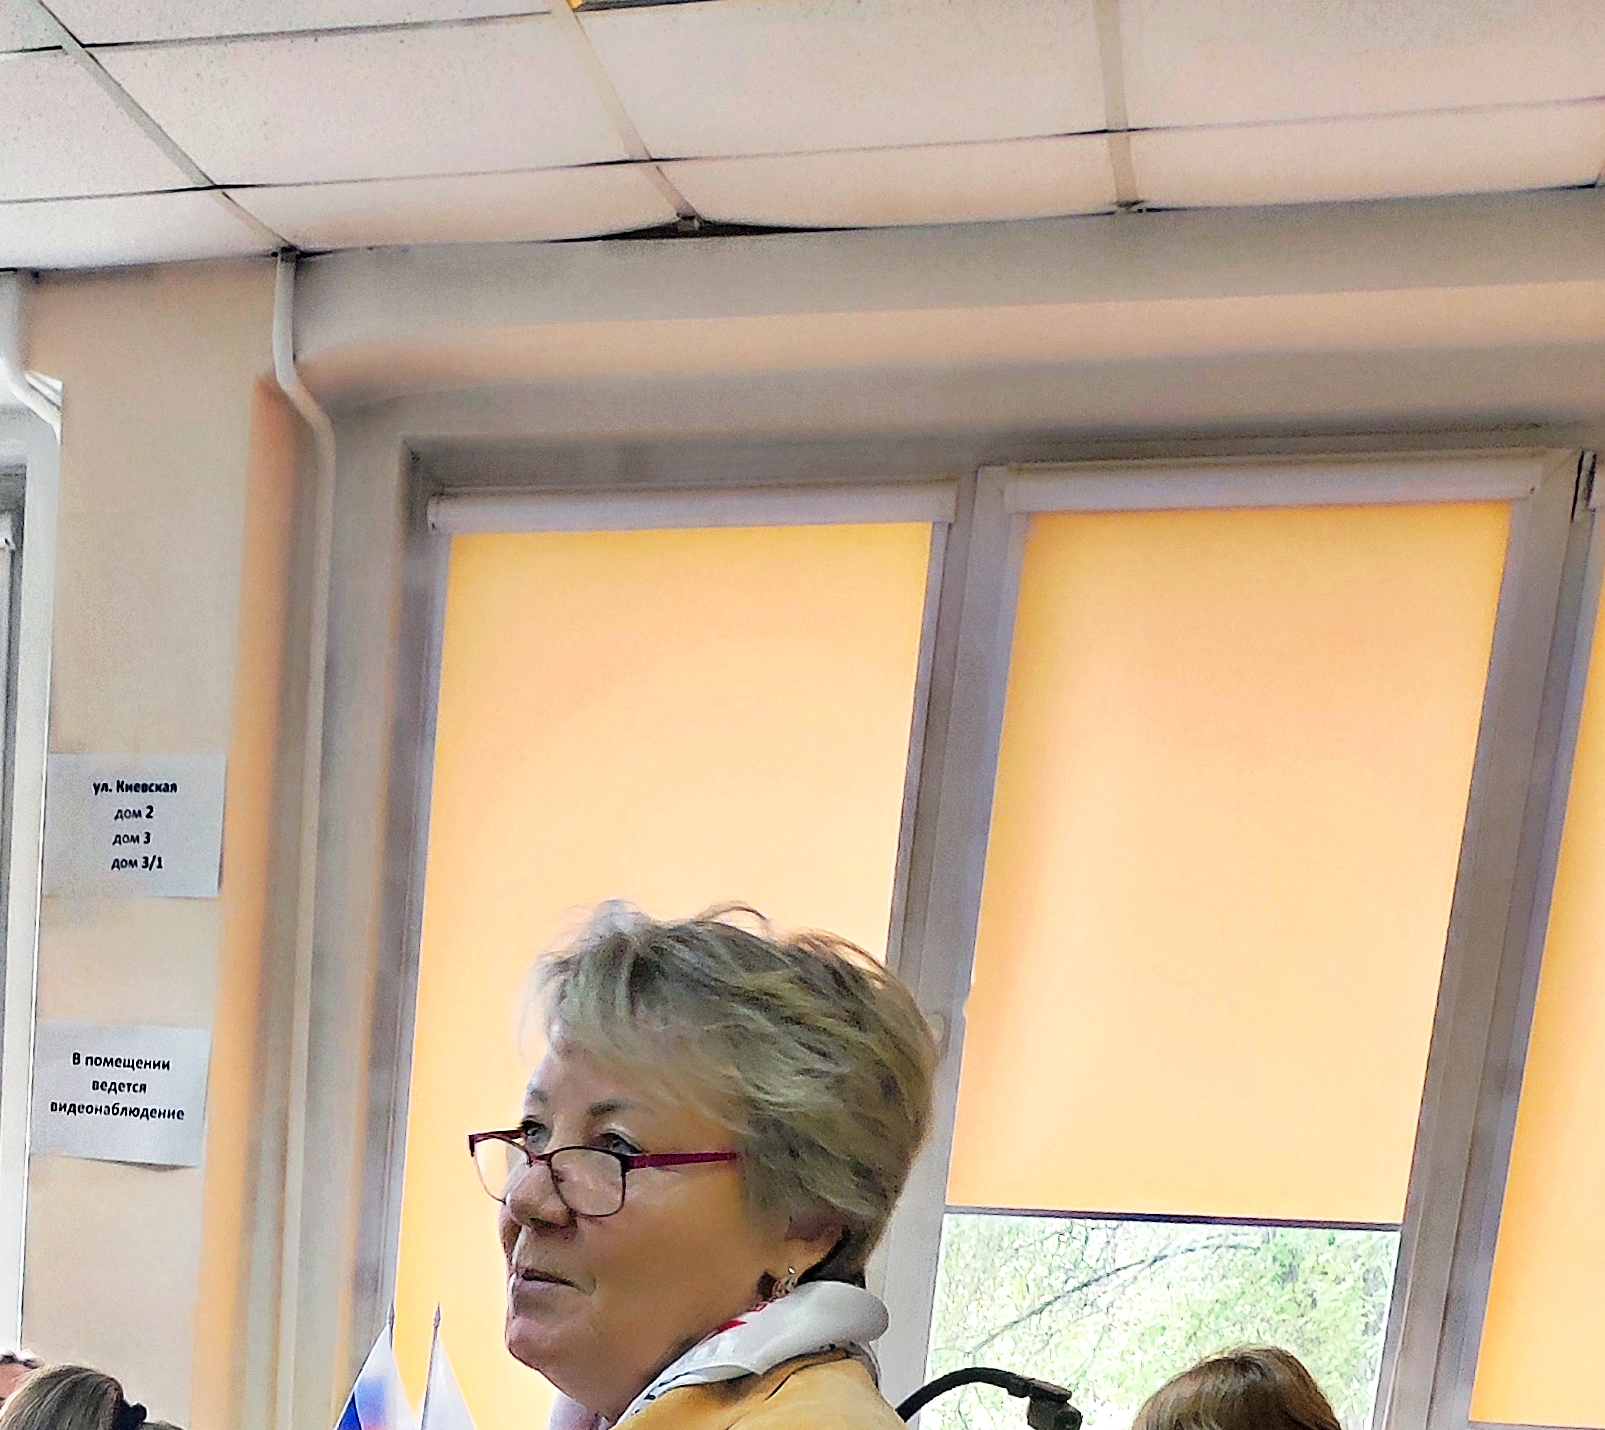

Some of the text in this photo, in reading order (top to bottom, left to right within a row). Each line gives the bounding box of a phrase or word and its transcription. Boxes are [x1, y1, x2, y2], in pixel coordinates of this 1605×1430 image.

[92, 779, 178, 796] ул. Киевская
[113, 804, 154, 821] дом 2
[112, 831, 151, 846] дом 3
[110, 854, 163, 872] дом 3/1
[72, 1052, 171, 1071] В помещении
[91, 1080, 147, 1095] ведется
[50, 1101, 185, 1121] видеонаблюдение
